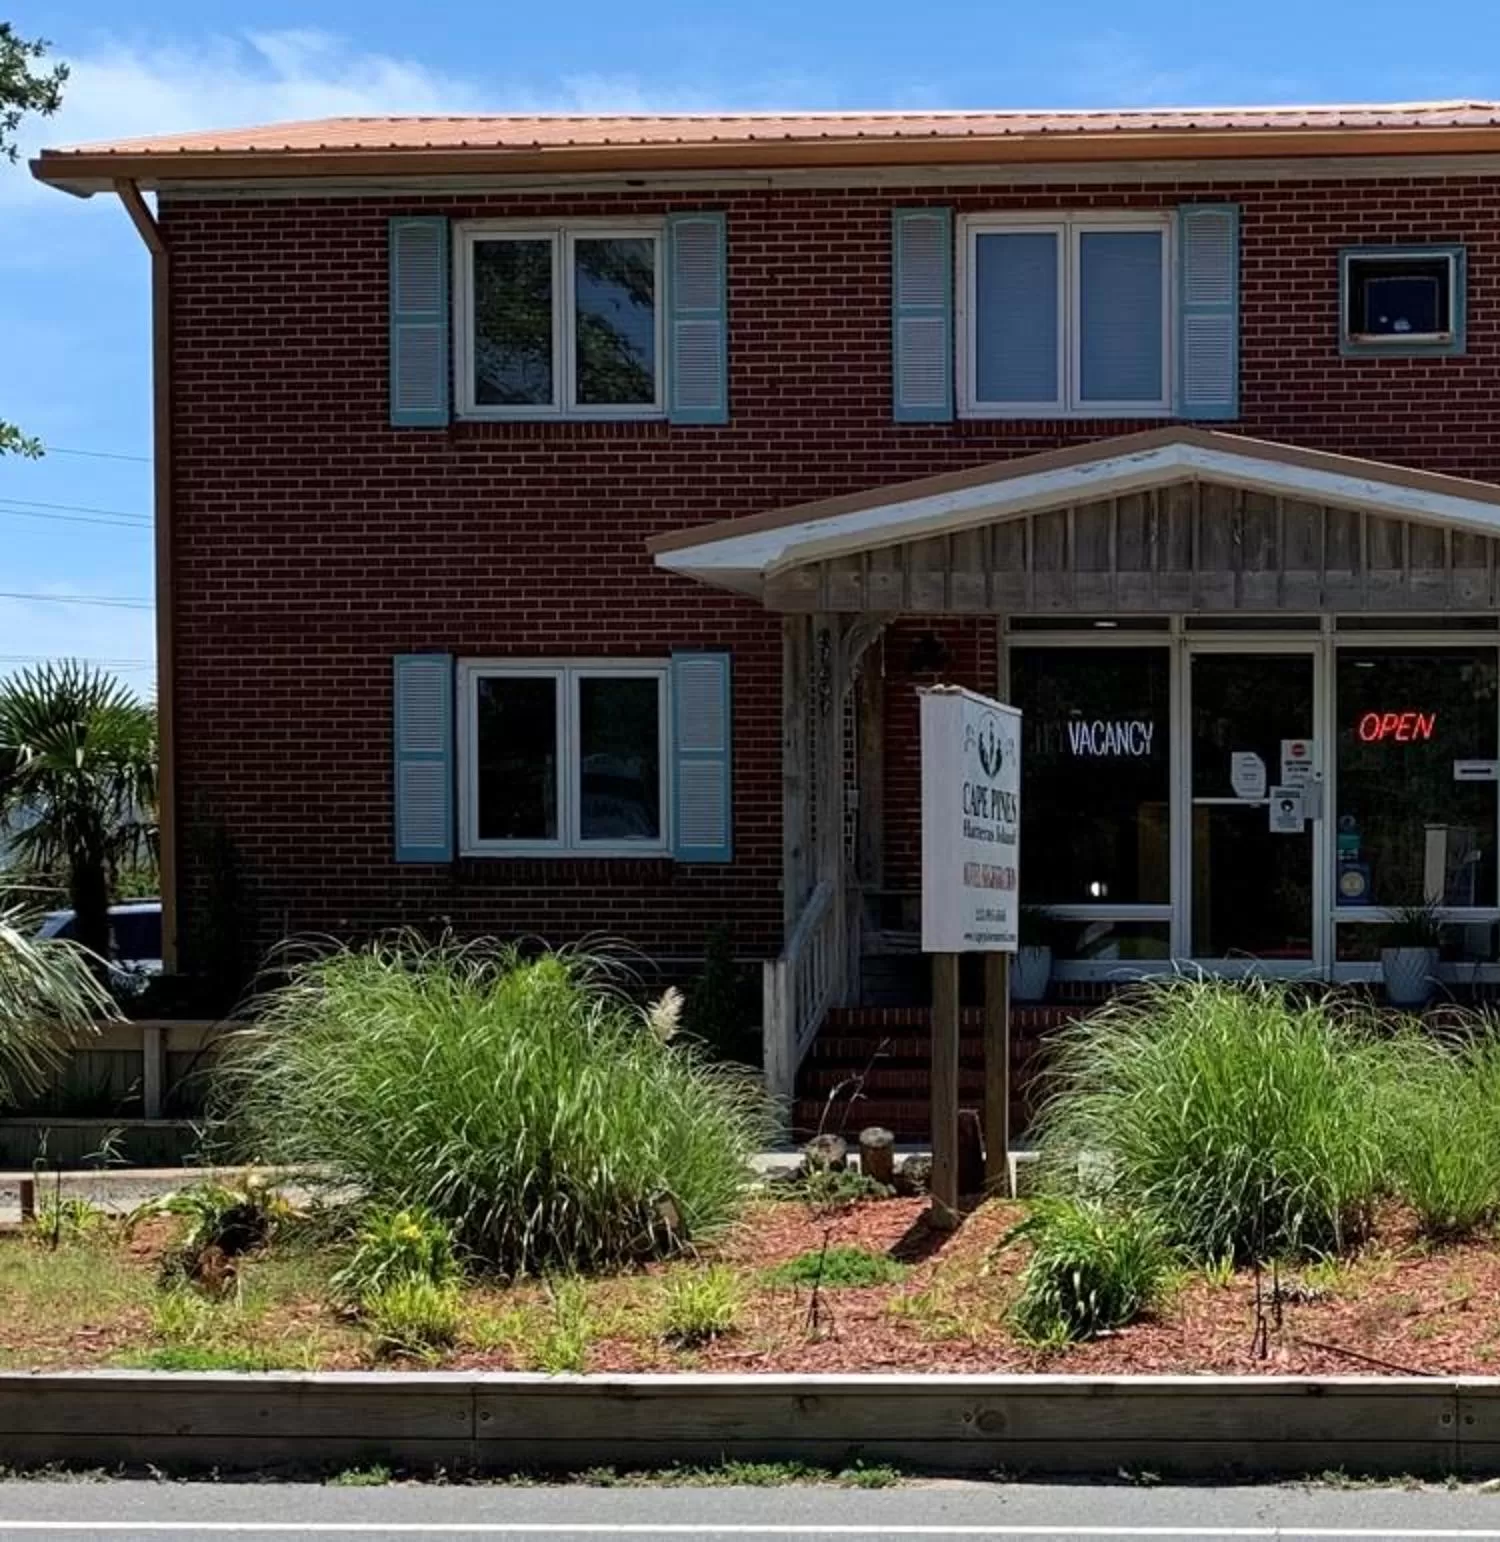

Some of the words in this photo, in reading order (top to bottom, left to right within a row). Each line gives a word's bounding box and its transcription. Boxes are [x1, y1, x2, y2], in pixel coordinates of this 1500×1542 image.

[1067, 719, 1153, 756] VACANCY
[1359, 712, 1436, 741] OPEN
[963, 781, 988, 818] CAPE
[991, 788, 1016, 824] PINES
